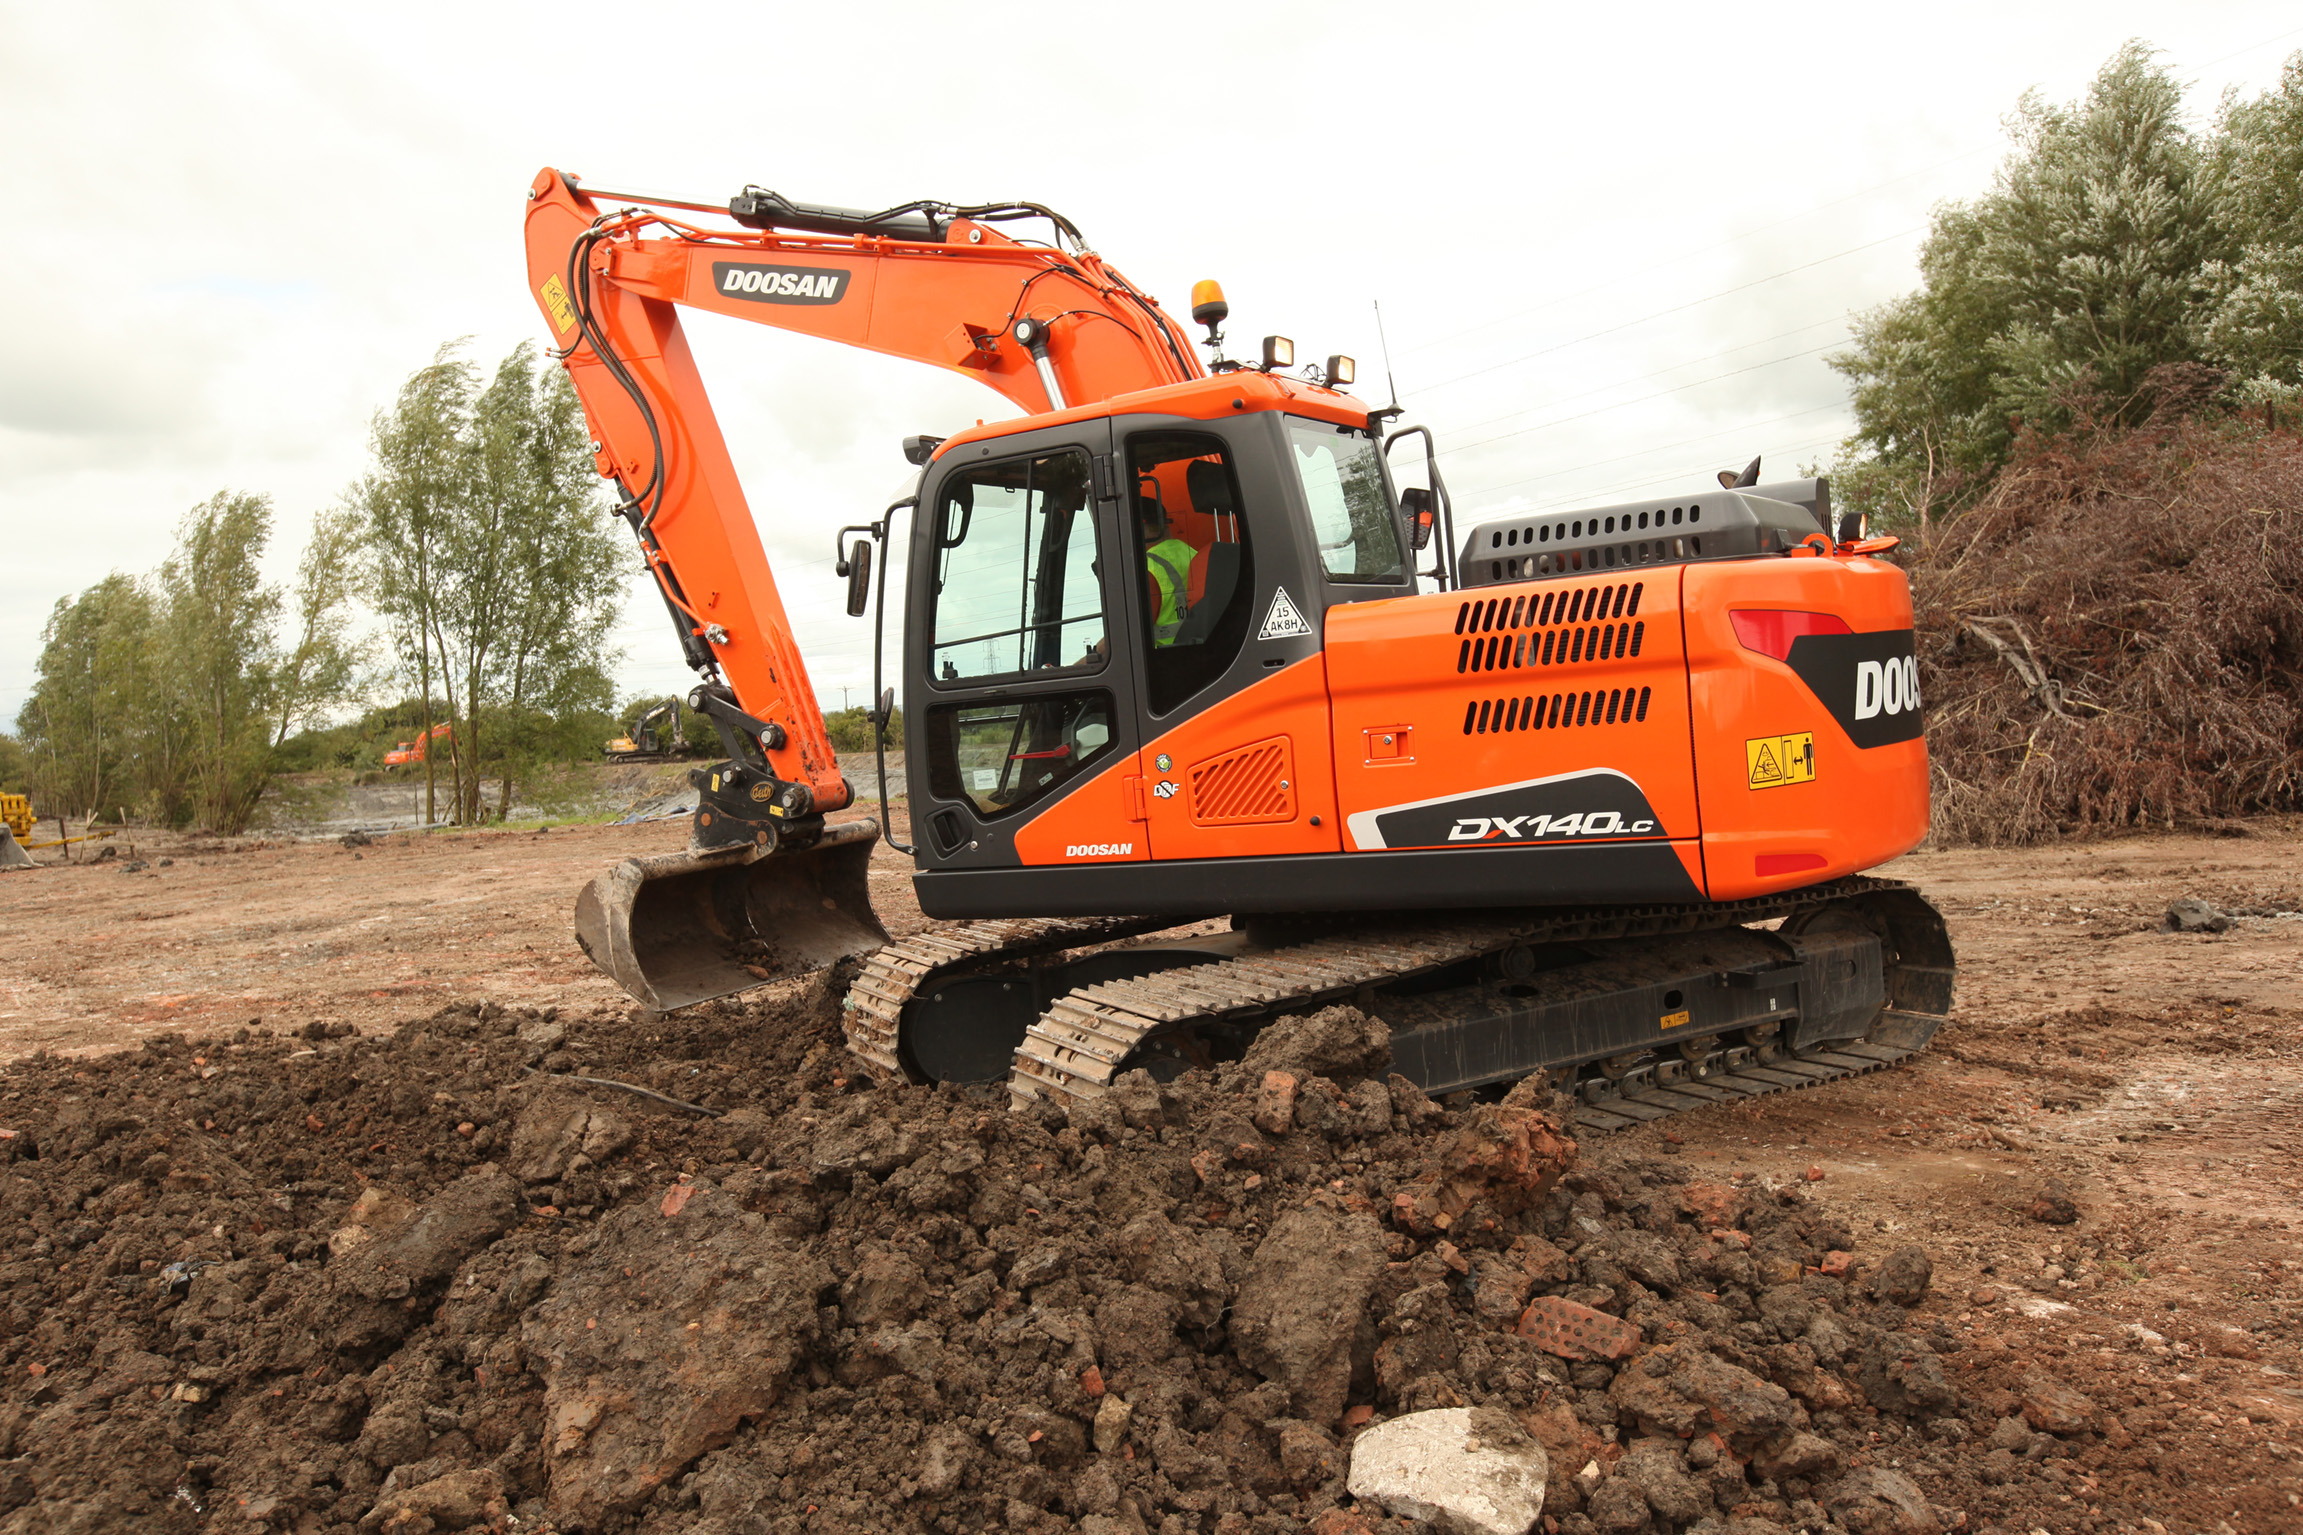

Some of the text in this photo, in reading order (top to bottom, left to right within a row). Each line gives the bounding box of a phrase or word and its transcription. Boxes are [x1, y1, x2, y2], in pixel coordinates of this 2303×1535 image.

[723, 269, 839, 298] DOOSAN
[1276, 606, 1290, 618] 15
[1270, 619, 1298, 632] AK8H
[1066, 843, 1133, 857] DOOSAN
